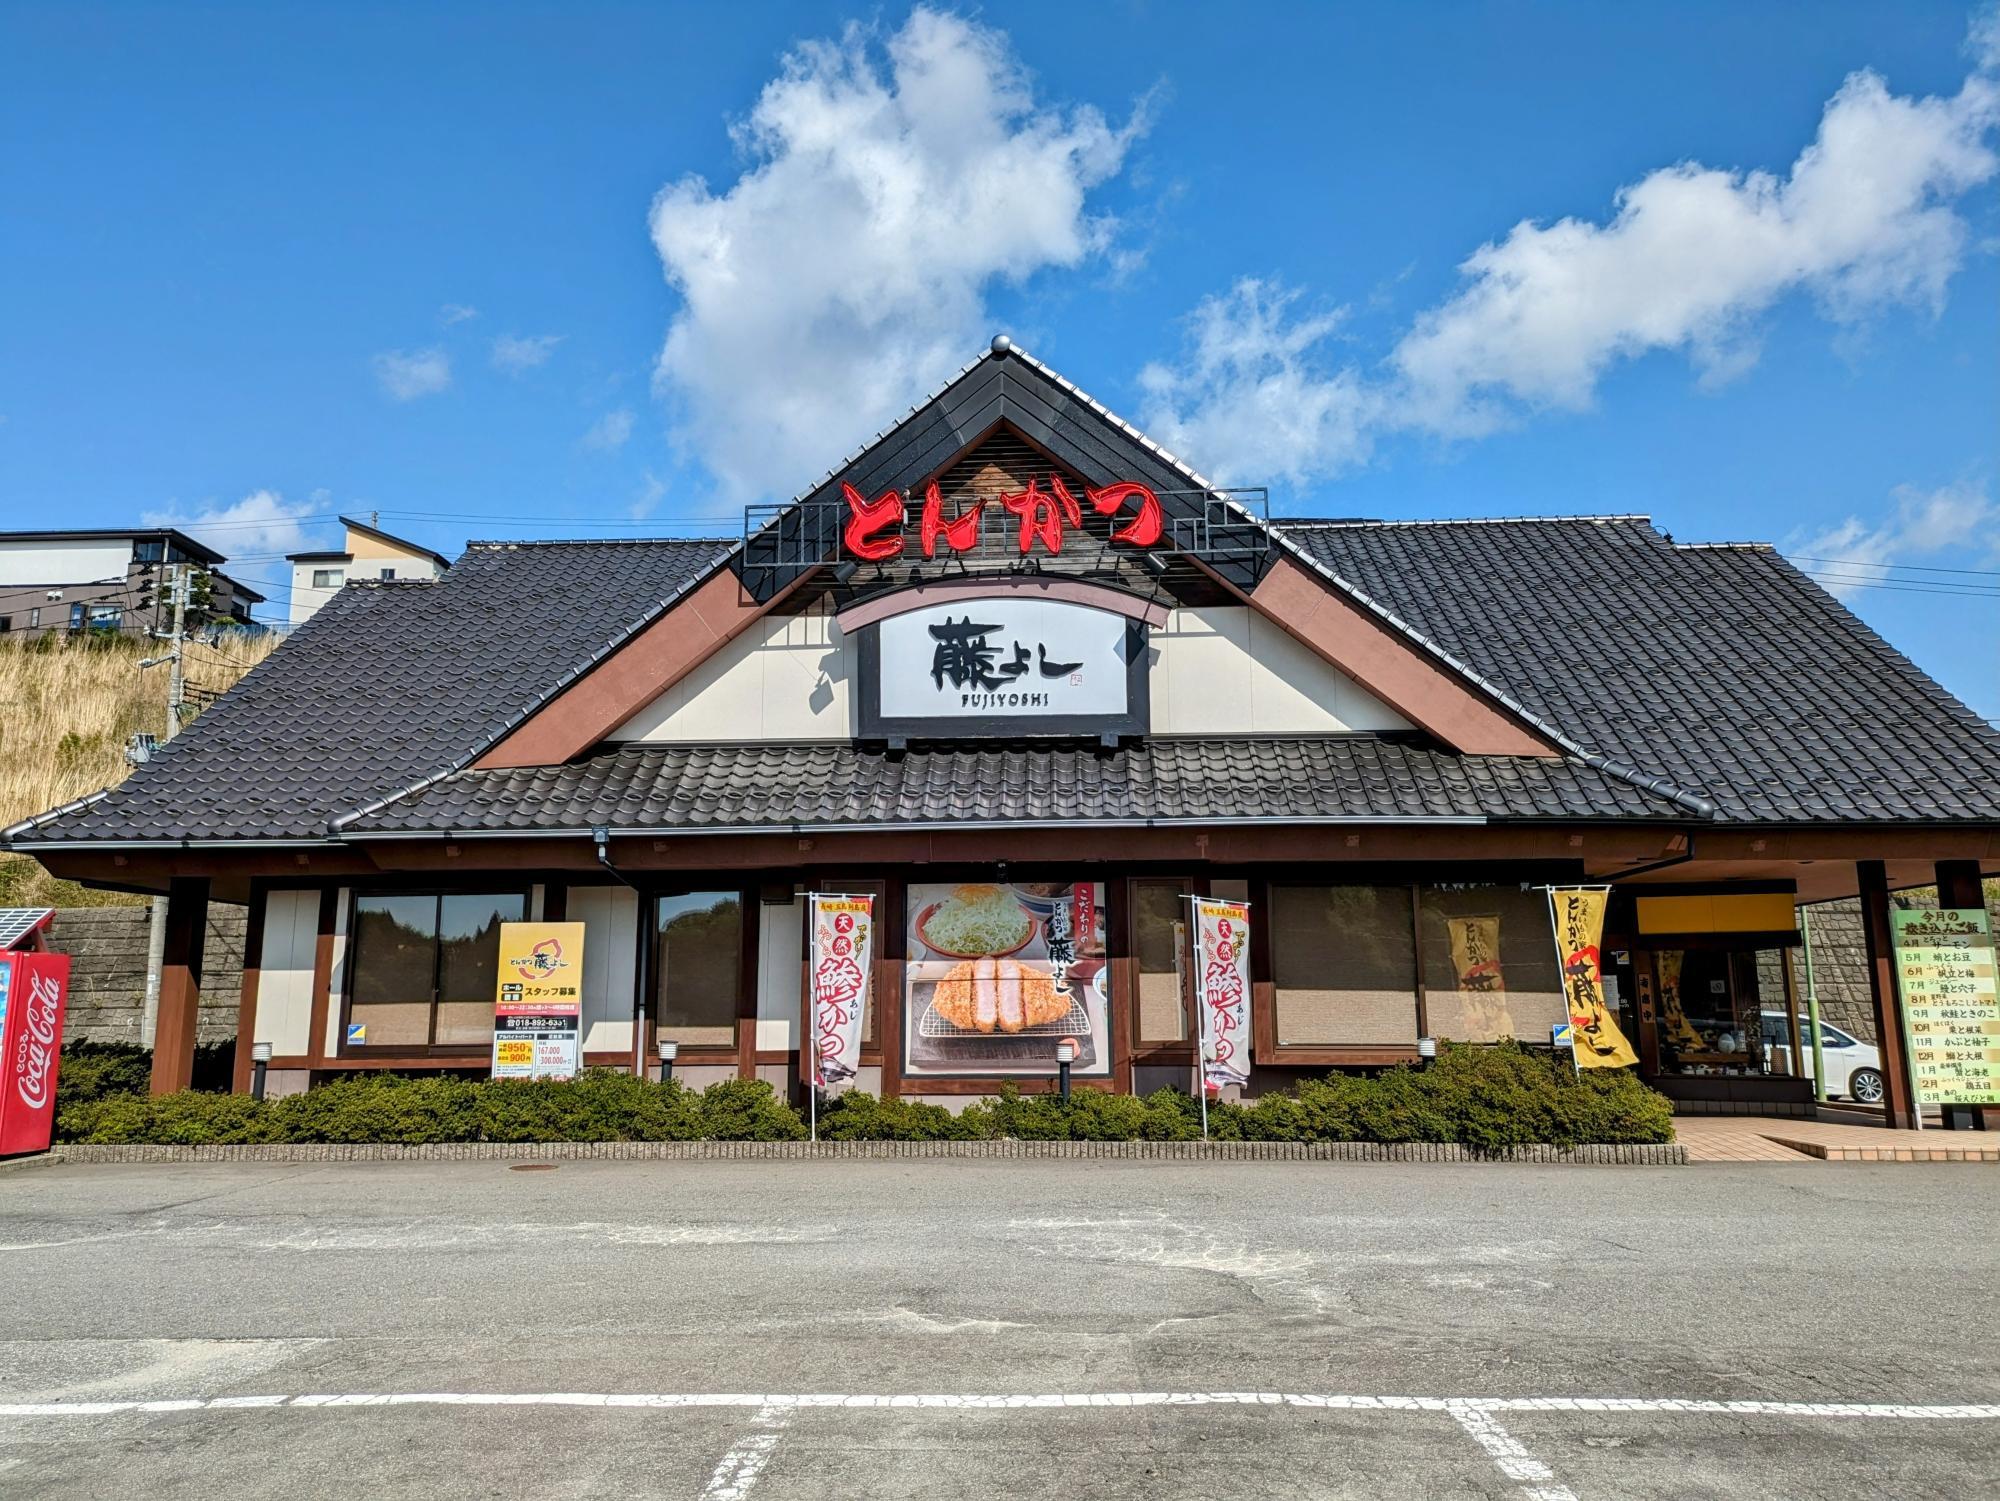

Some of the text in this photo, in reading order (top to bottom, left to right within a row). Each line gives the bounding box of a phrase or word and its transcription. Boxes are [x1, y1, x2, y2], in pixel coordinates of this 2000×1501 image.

[841, 472, 1164, 561] とんかつ
[928, 615, 1084, 693] 藤よし
[961, 693, 1049, 710] FUJIYOSHI
[1078, 889, 1091, 944] こだわりの
[1921, 911, 1959, 922] 今月の
[1567, 895, 1580, 952] とんかつ
[1905, 922, 1980, 935] 炊き込みご飯
[835, 915, 851, 954] 天然
[1219, 921, 1233, 958] 天然
[1048, 901, 1080, 993] とんかつ 藤よし
[1903, 940, 1971, 949] 4月 サーモン
[1905, 953, 1921, 962] 5月
[1907, 967, 1923, 976] 6月
[1909, 981, 1925, 990] 7月
[524, 987, 576, 996] スタッフ募集
[1911, 995, 1927, 1004] 8月
[850, 999, 858, 1020] あじ
[1236, 1003, 1244, 1026] あじ
[1912, 1009, 1996, 1018] 9月 秋鮭ときのこ
[1914, 1023, 1930, 1032] 10月
[18, 967, 60, 1109] Coca-Cola
[1916, 1038, 1932, 1046] 11月
[1918, 1052, 1935, 1060] 12月
[1921, 1065, 1936, 1074] 1月
[1922, 1079, 1938, 1088] 2月
[1924, 1093, 1940, 1101] 3月
